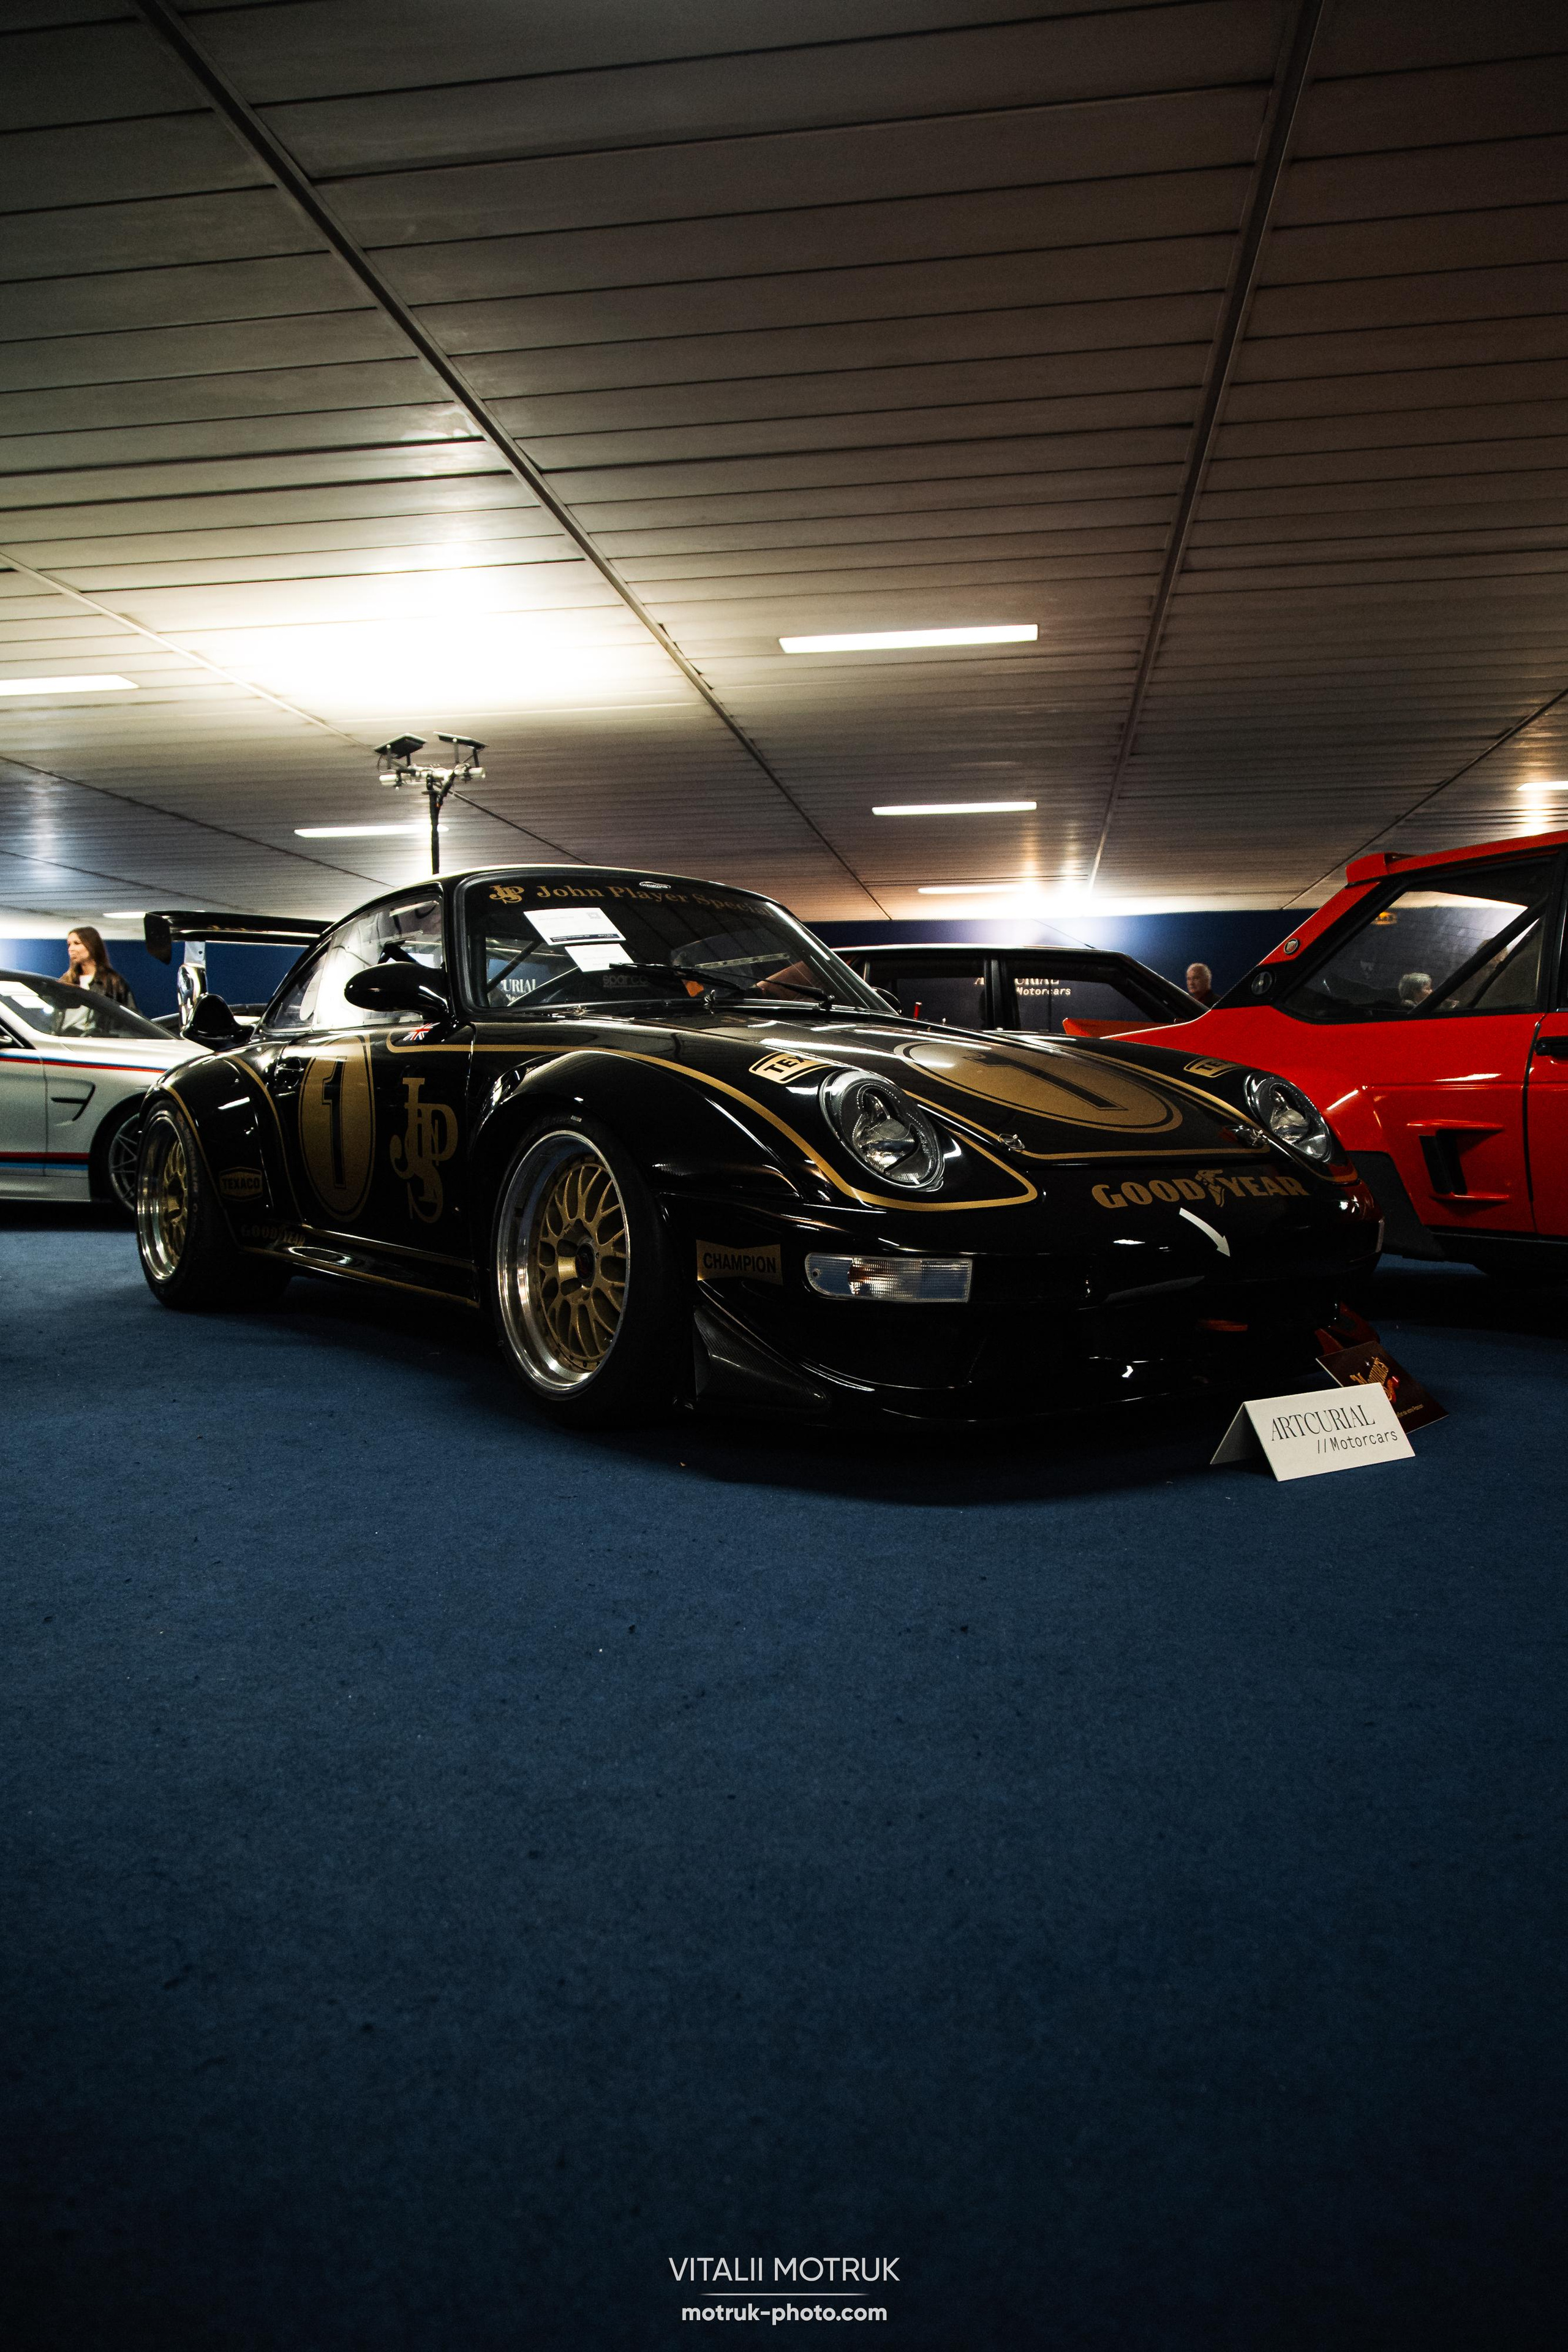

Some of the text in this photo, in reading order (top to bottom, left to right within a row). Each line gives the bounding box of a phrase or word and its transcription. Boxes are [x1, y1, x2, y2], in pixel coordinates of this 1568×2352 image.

[537, 884, 605, 898] John
[606, 885, 688, 903] Player
[692, 892, 775, 918] Special
[962, 1049, 1129, 1111] 1
[322, 1057, 348, 1189] 1
[222, 1177, 260, 1189] TEXACO
[1091, 1169, 1311, 1209] GOODYEAR
[704, 1253, 776, 1273] CHAMPION
[1271, 1404, 1375, 1441] ARTCURIAL
